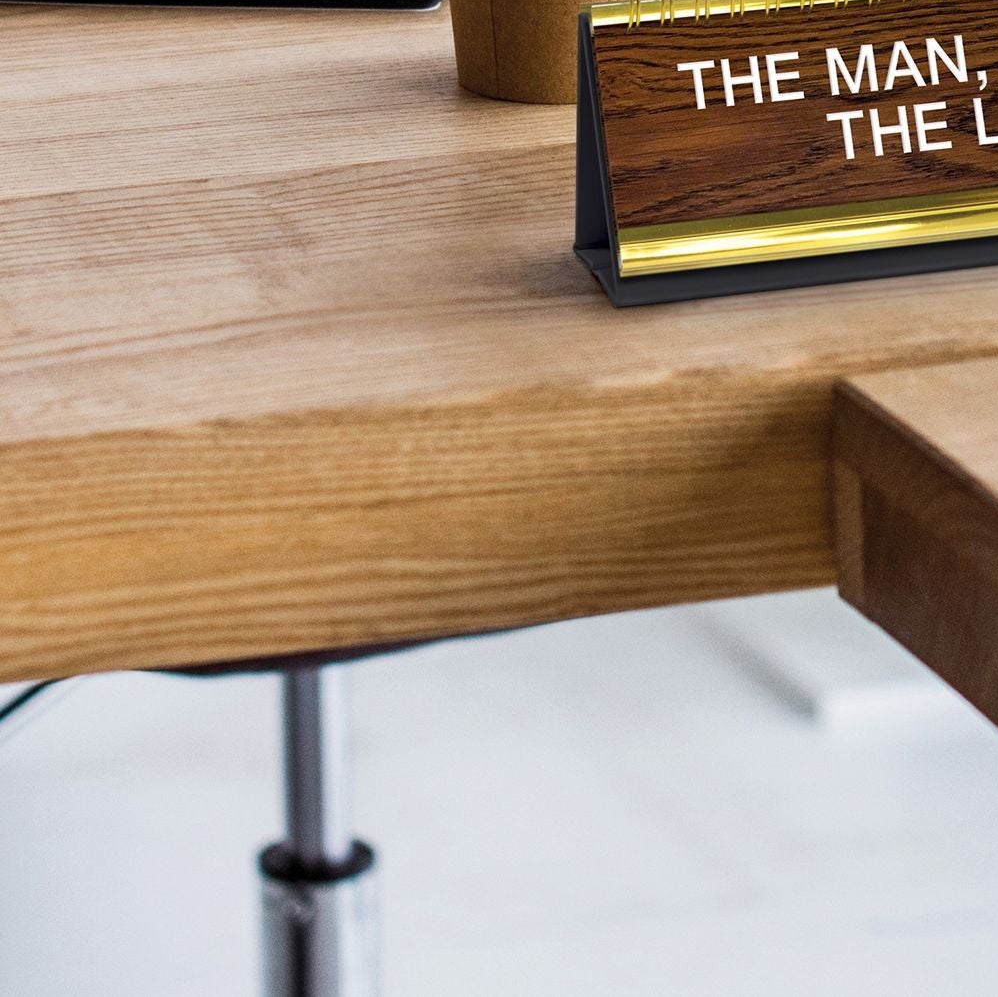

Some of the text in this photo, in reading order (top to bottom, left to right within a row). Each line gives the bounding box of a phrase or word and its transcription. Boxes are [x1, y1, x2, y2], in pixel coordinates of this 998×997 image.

[677, 52, 805, 110] THE
[826, 34, 989, 97] MAN,
[826, 101, 953, 160] THE
